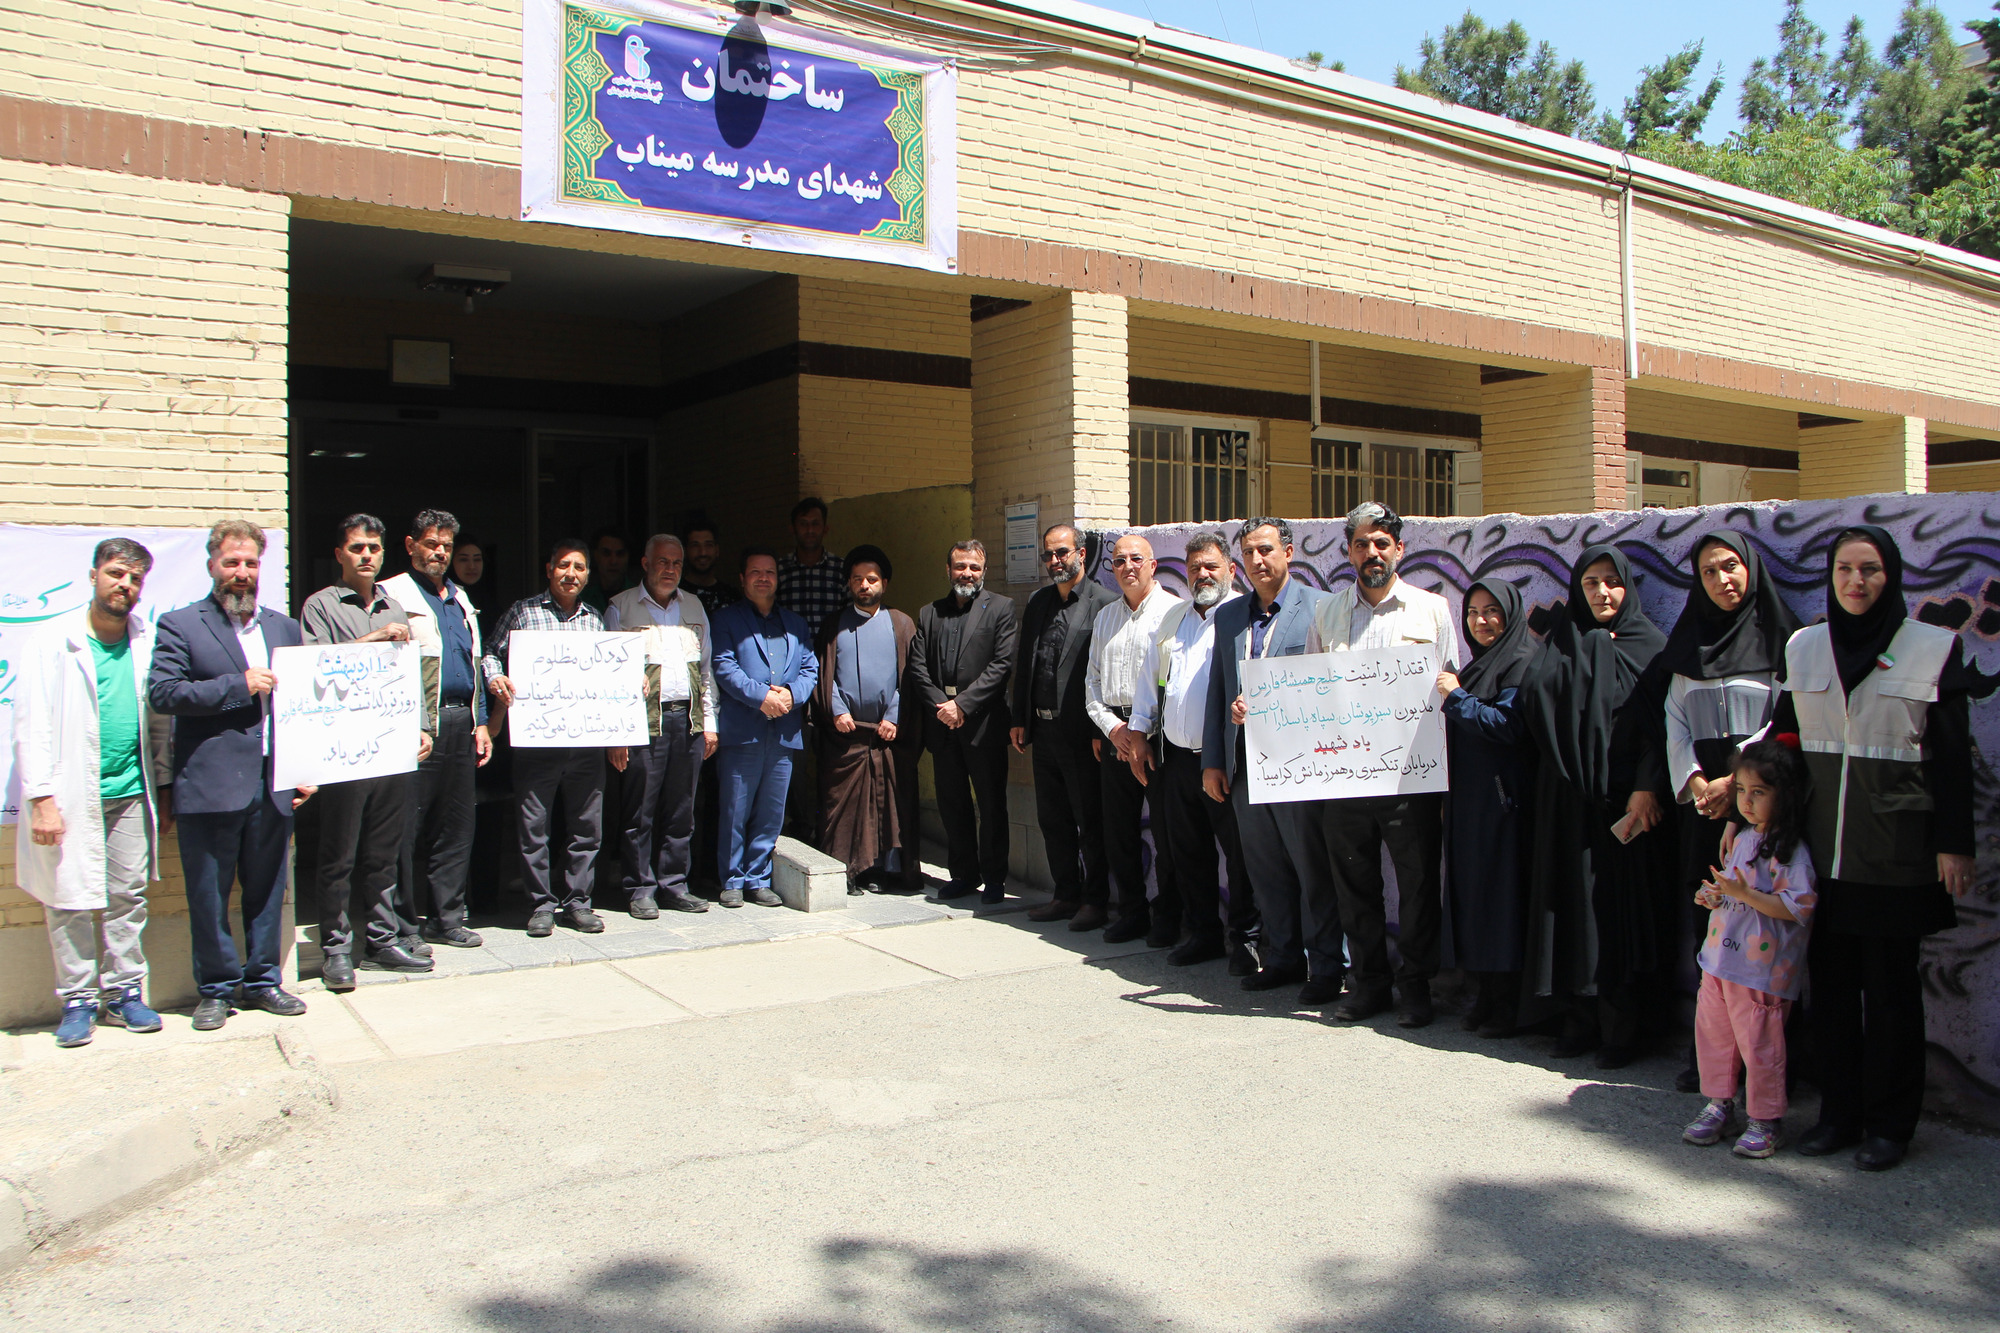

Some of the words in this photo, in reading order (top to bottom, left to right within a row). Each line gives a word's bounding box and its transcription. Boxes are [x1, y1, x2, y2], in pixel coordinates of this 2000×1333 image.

[681, 48, 845, 113] ساختمان
[615, 133, 695, 179] میناب
[701, 149, 790, 191] مدرسه
[797, 163, 883, 205] شهدای
[533, 644, 577, 675] مظلوم
[579, 636, 642, 672] کودکان
[321, 655, 373, 681] اردیبهشت
[1380, 670, 1390, 682] و
[1386, 656, 1430, 685] اقتدار
[515, 682, 554, 707] میناب
[552, 679, 598, 708] مدرسه
[1250, 671, 1280, 697] فارس
[1280, 670, 1316, 693] همیشه
[1316, 668, 1343, 695] خلیج
[396, 690, 416, 714] روز
[626, 691, 638, 708] و
[1395, 699, 1433, 722] مدیون
[1310, 706, 1335, 729] سپاه
[1314, 735, 1347, 755] شهید
[1353, 735, 1371, 751] یاد
[1401, 754, 1437, 779] دریابان
